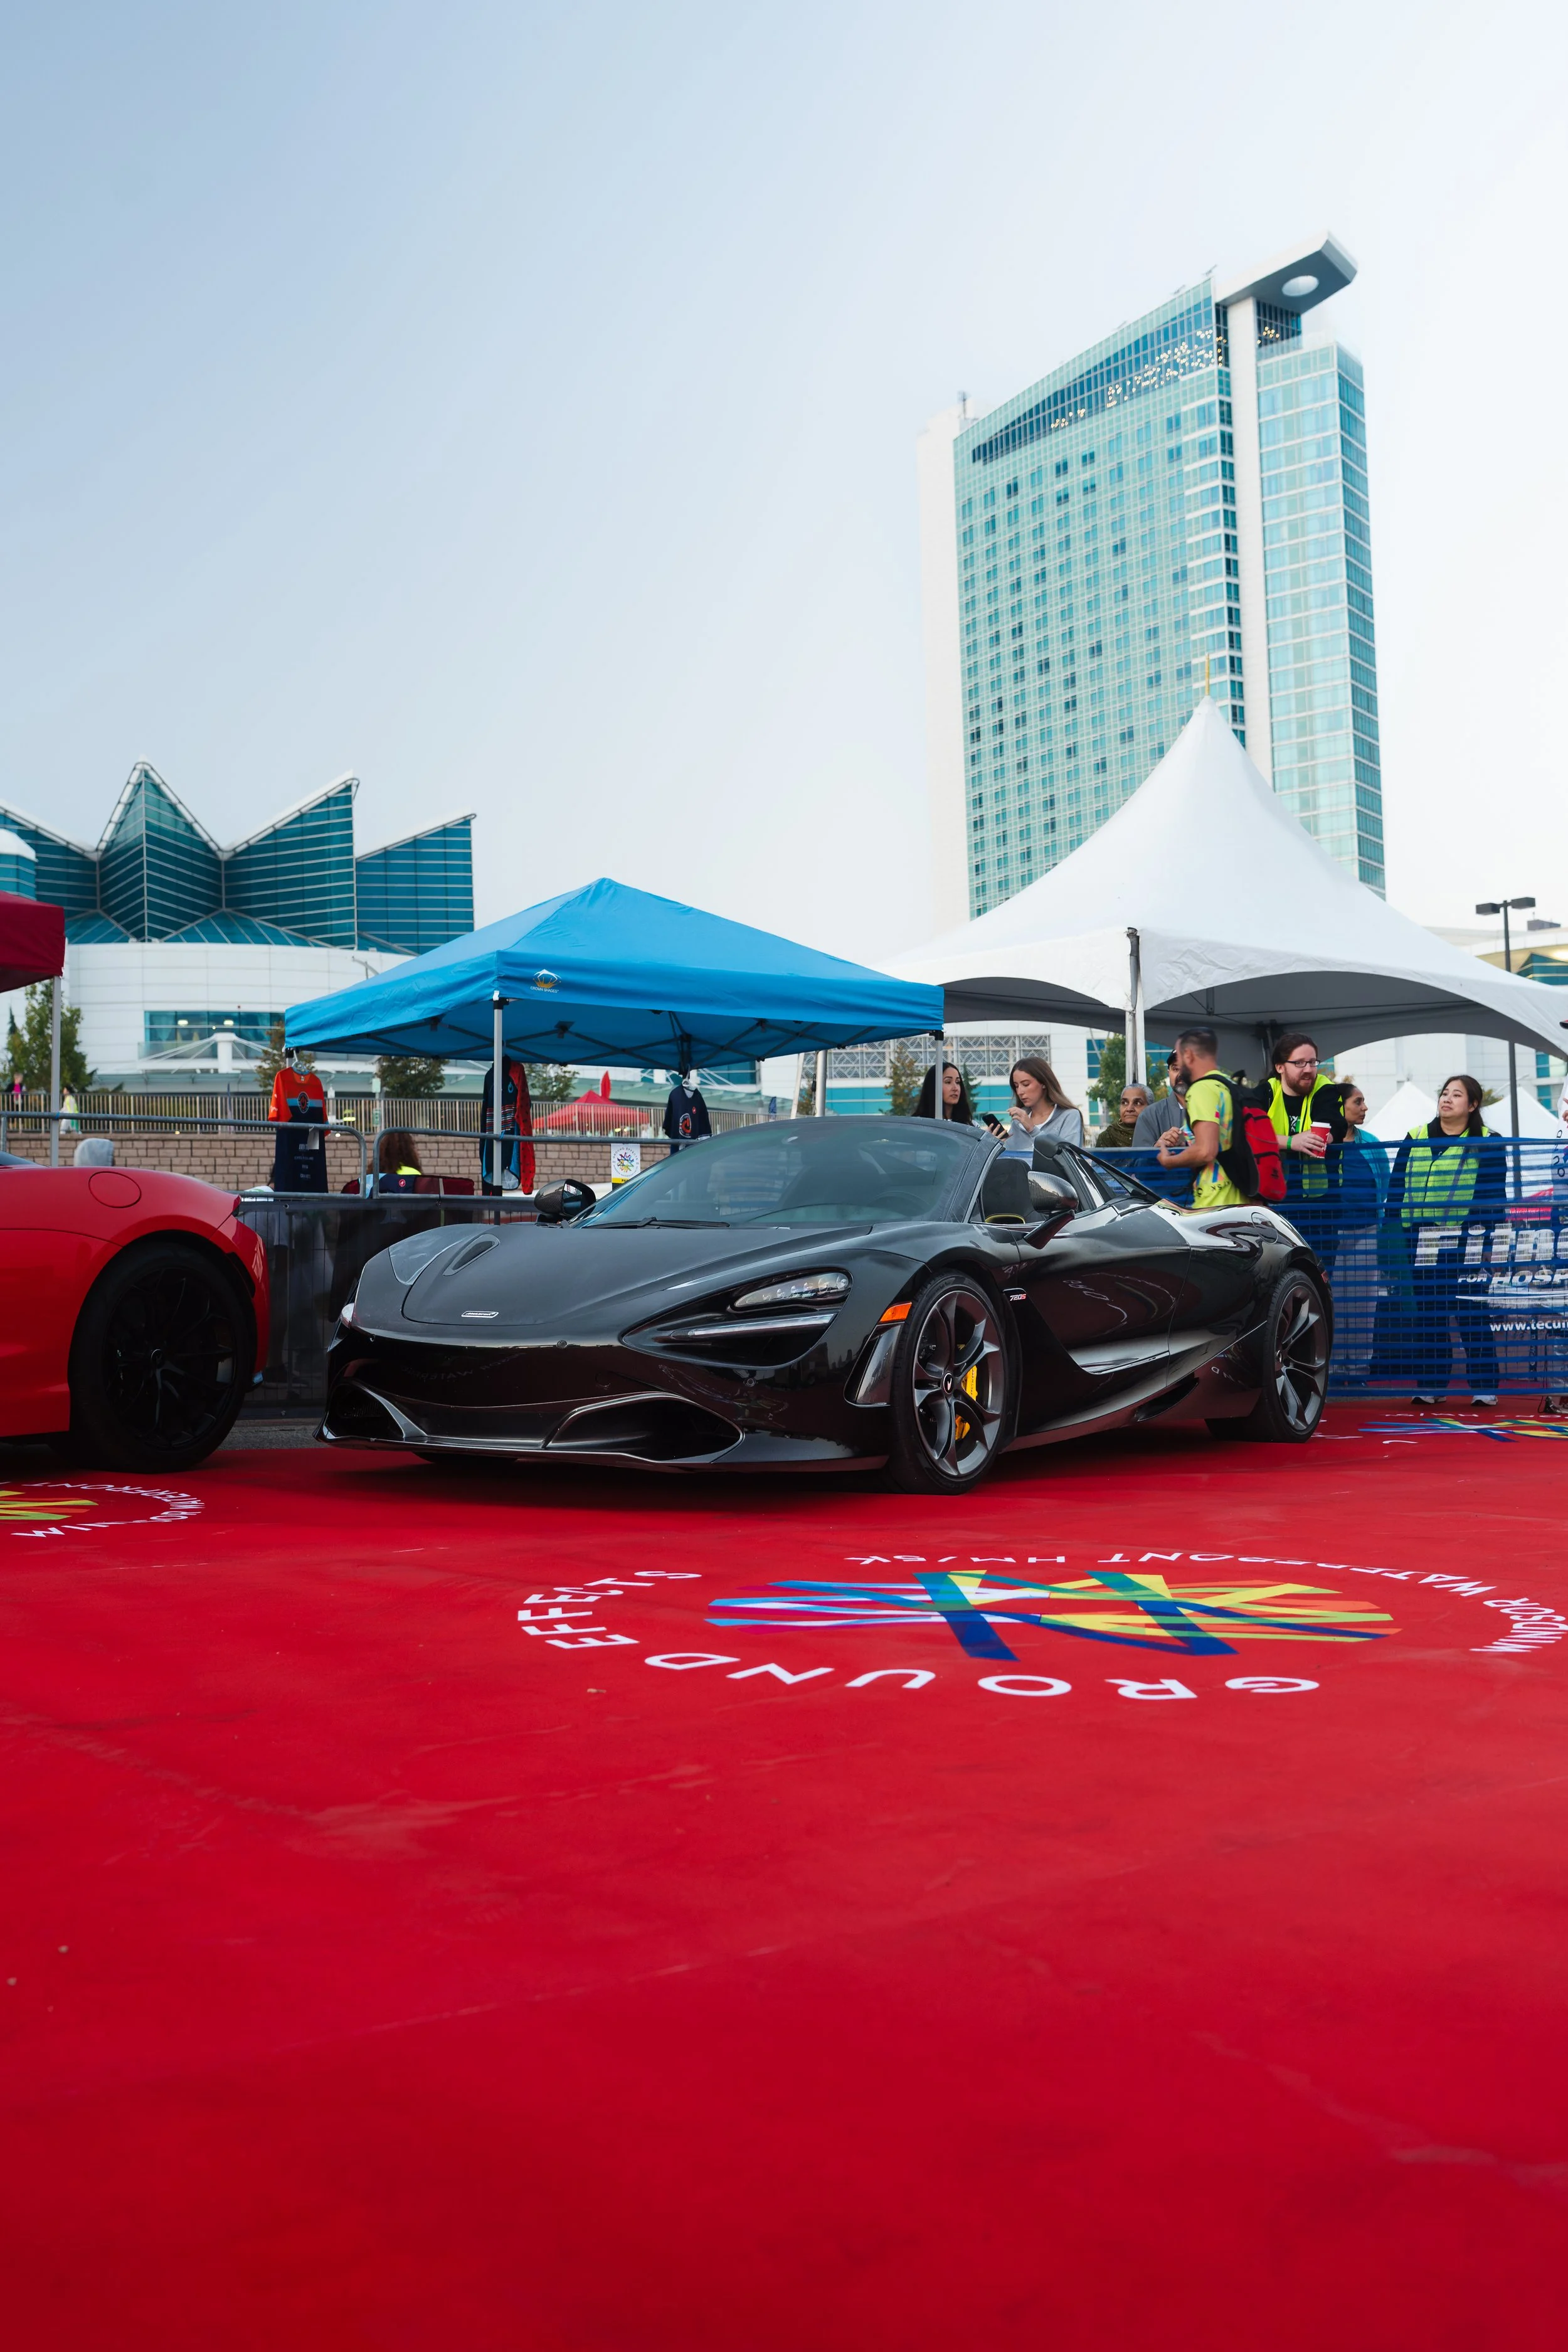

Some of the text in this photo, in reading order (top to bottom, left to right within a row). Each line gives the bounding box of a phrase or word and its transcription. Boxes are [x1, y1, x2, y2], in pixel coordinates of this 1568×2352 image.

[1010, 1293, 1027, 1301] 720S
[517, 1571, 1320, 1700] GROUND EFFECTS
[1469, 1597, 1568, 1652] WINDSOR
